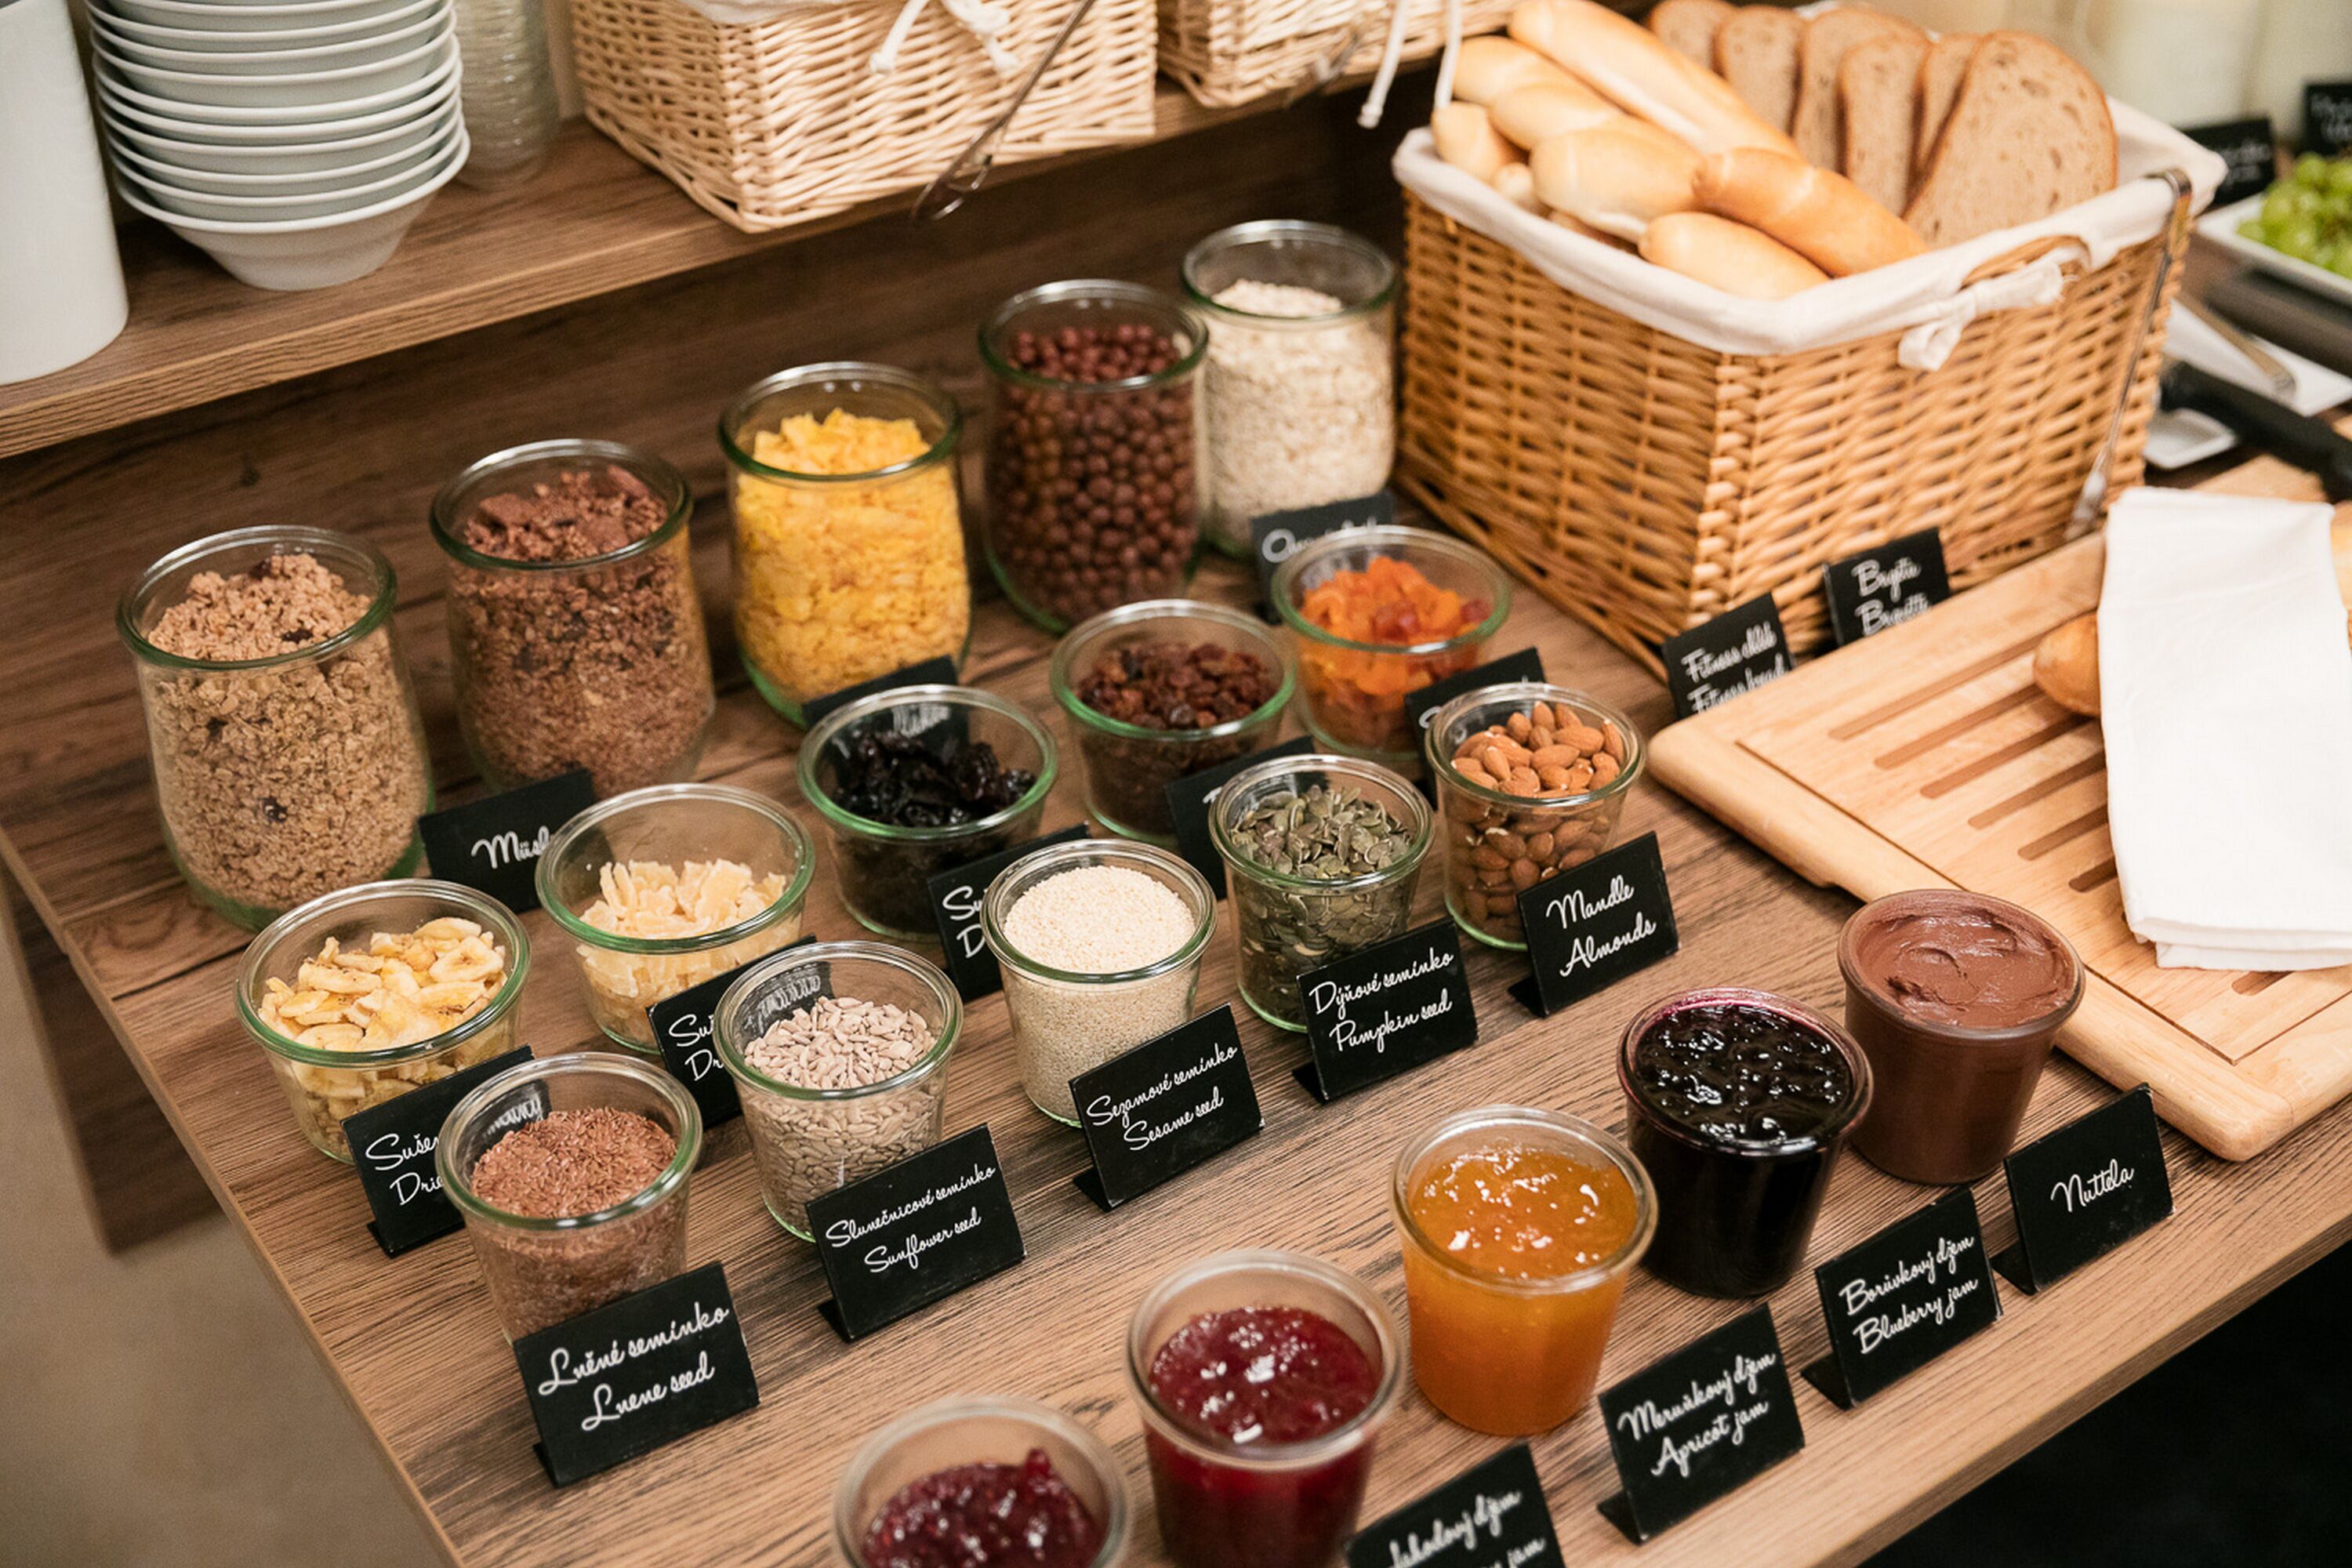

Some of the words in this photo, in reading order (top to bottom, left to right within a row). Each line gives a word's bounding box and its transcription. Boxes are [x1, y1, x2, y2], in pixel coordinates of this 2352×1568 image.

[1681, 648, 1742, 684] Fitness
[471, 826, 550, 869] Müsl
[1546, 874, 1635, 929] Mandle
[1559, 912, 1657, 977] Almonds
[1330, 1011, 1420, 1053] Pumpkin
[1421, 988, 1453, 1020] seed
[1087, 1073, 1173, 1128] Sezamové
[1123, 1112, 1195, 1151] Sesame
[1196, 1086, 1224, 1117] seed
[390, 1172, 444, 1206] Drie
[826, 1189, 935, 1247] Slunečnicové
[864, 1234, 954, 1272] Sunflower
[954, 1207, 982, 1234] seed
[1853, 1298, 1943, 1355] Blueberry
[1944, 1279, 1978, 1319] jam
[670, 1350, 715, 1392] seed
[1650, 1413, 1730, 1478] Apricot
[1731, 1400, 1769, 1446] jam
